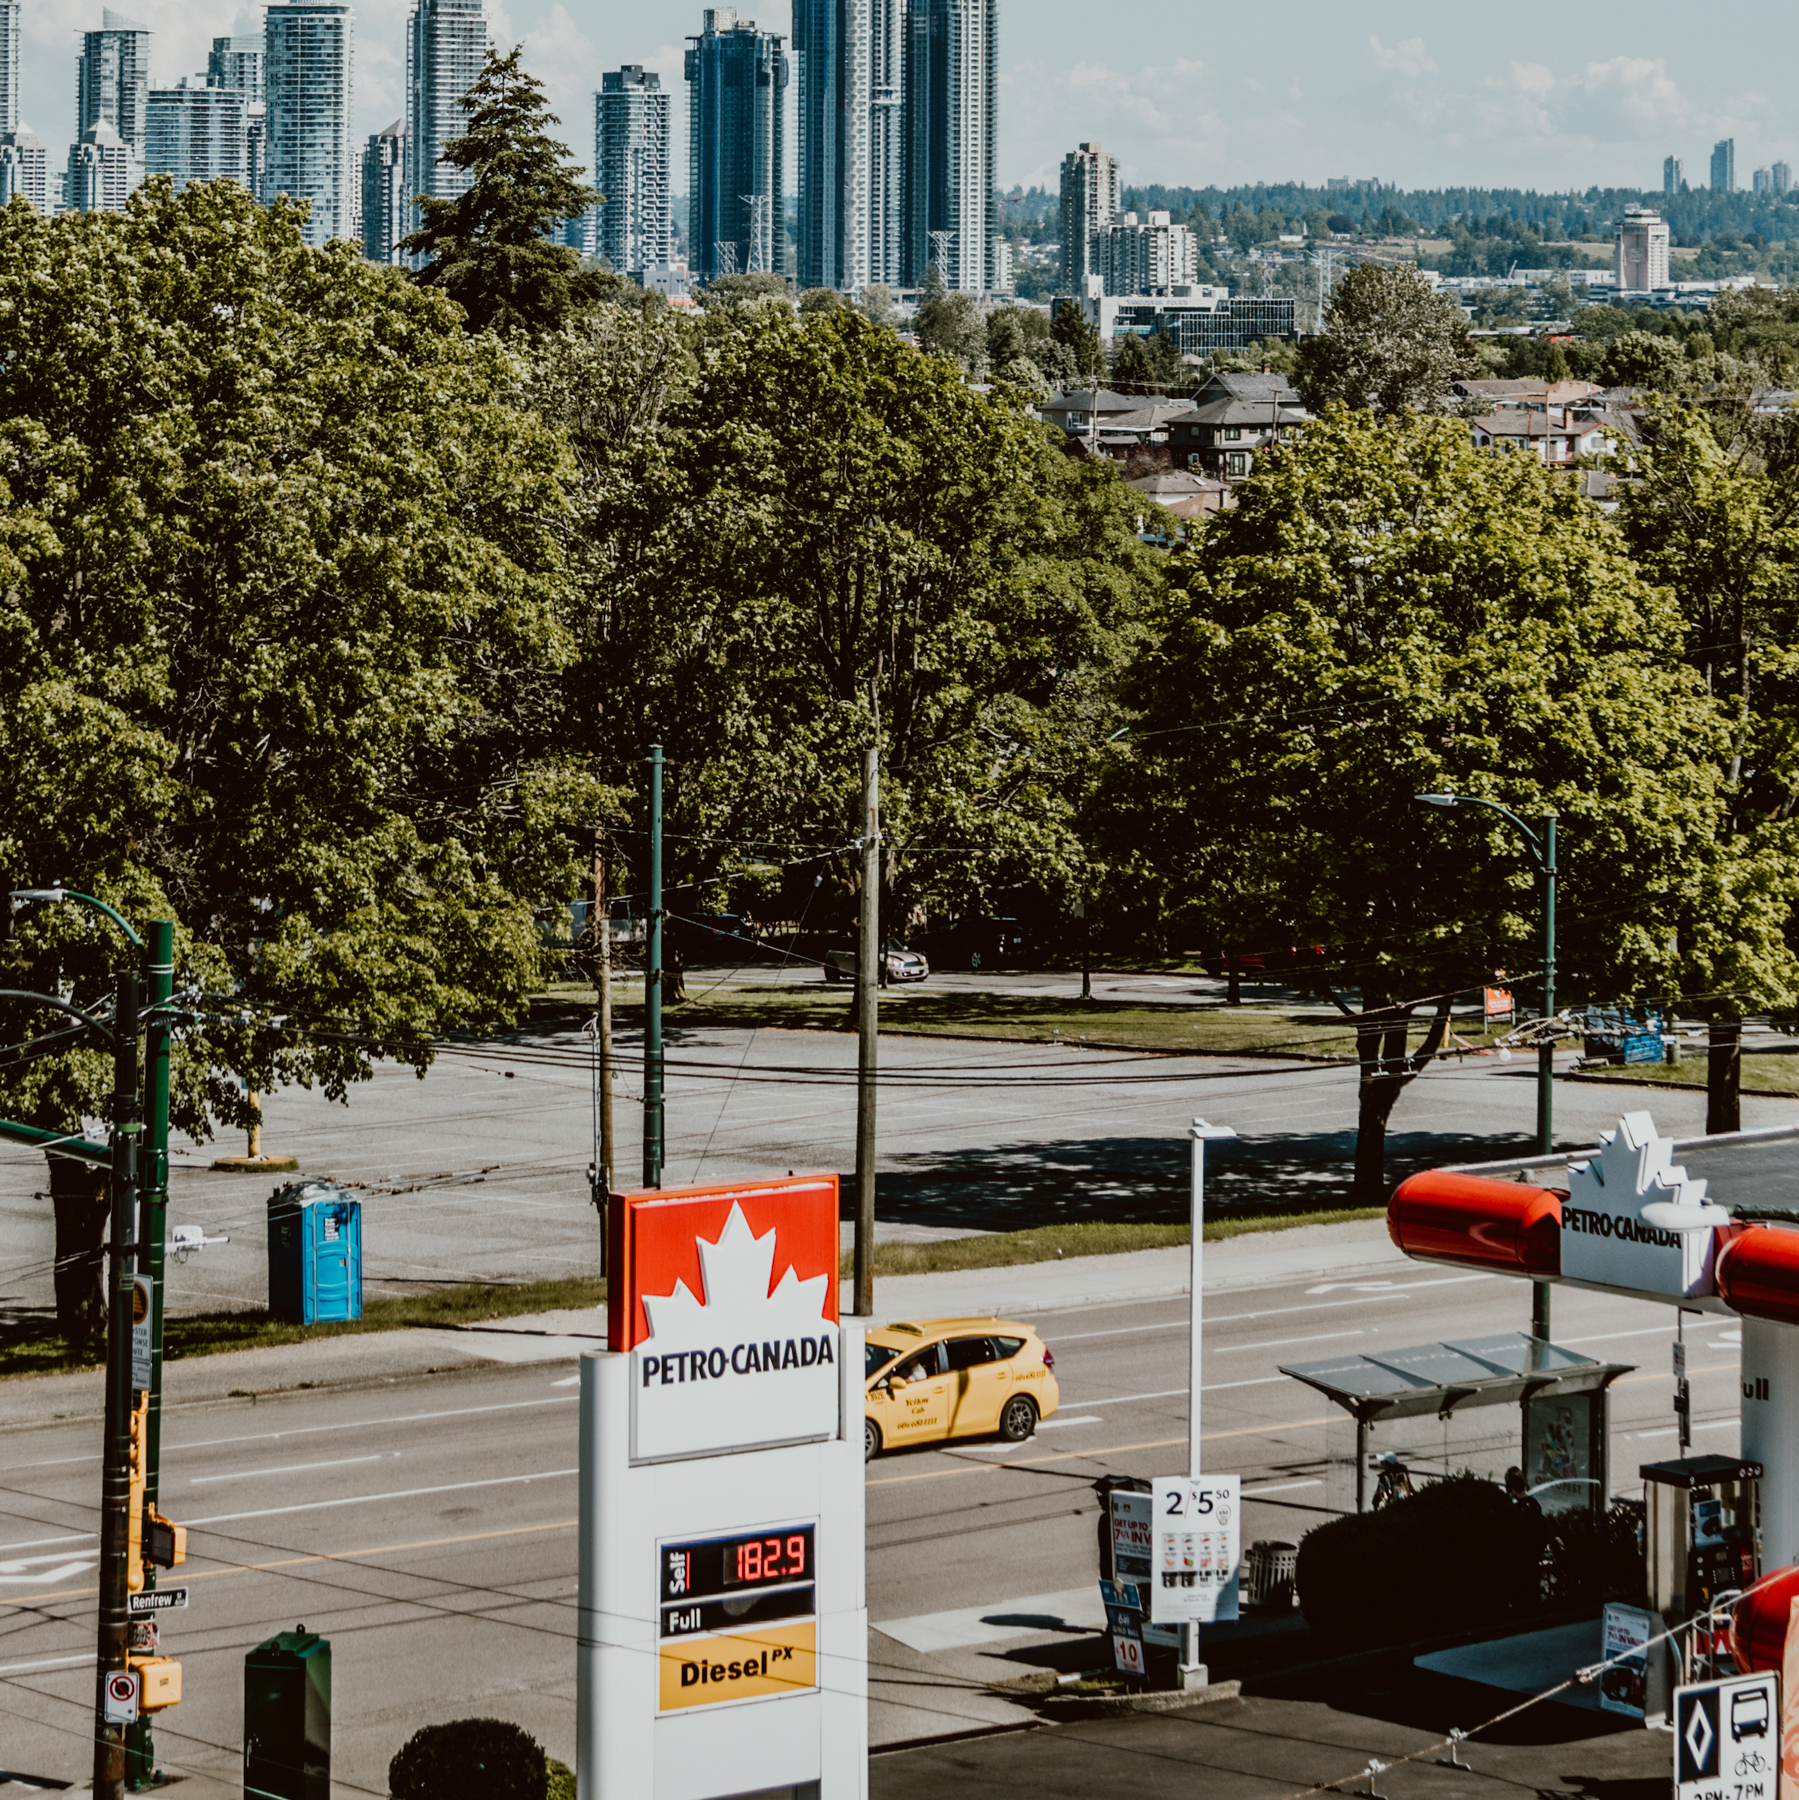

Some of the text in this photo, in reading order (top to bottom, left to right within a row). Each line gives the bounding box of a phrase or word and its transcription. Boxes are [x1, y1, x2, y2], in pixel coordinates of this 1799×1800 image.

[1561, 1205, 1682, 1250] PETRO-CANADA
[642, 1334, 835, 1388] PETRO-CANADA
[1742, 1378, 1769, 1400] ull
[906, 1398, 929, 1406] Yellow
[1114, 1518, 1148, 1531] GET UP TO
[1131, 1531, 1142, 1544] IN
[669, 1535, 805, 1595] Self 182.9
[133, 1593, 172, 1609] Renfrew
[669, 1608, 701, 1633] Full
[681, 1647, 793, 1687] Diesel PX
